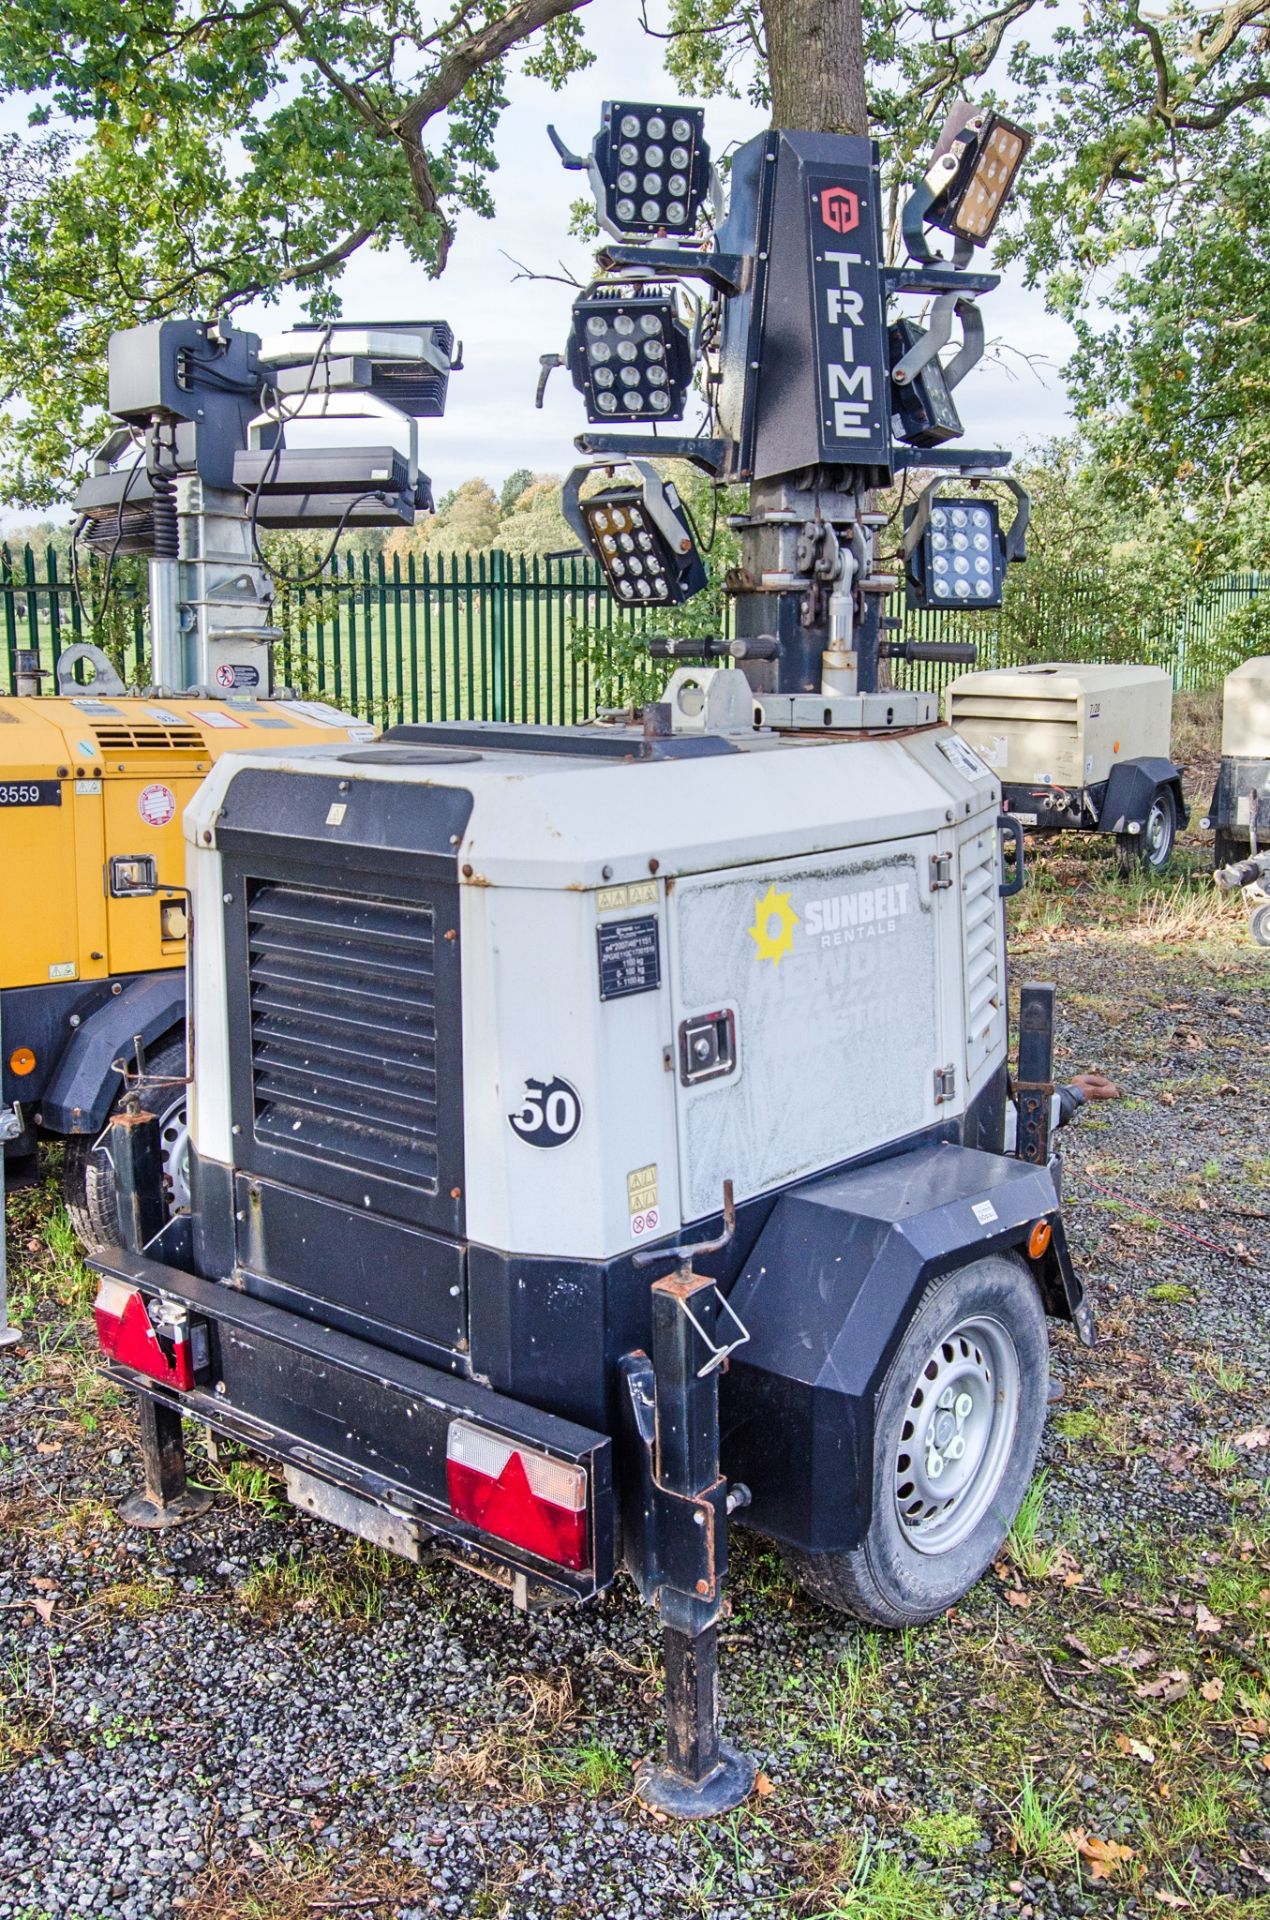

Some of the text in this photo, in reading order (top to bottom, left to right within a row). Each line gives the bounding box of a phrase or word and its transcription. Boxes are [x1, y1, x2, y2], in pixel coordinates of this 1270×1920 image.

[823, 251, 873, 438] TRIME
[0, 785, 40, 803] 3559
[804, 883, 910, 936] SUNBELT
[821, 919, 897, 948] RENTALS
[512, 1088, 576, 1135] 50
